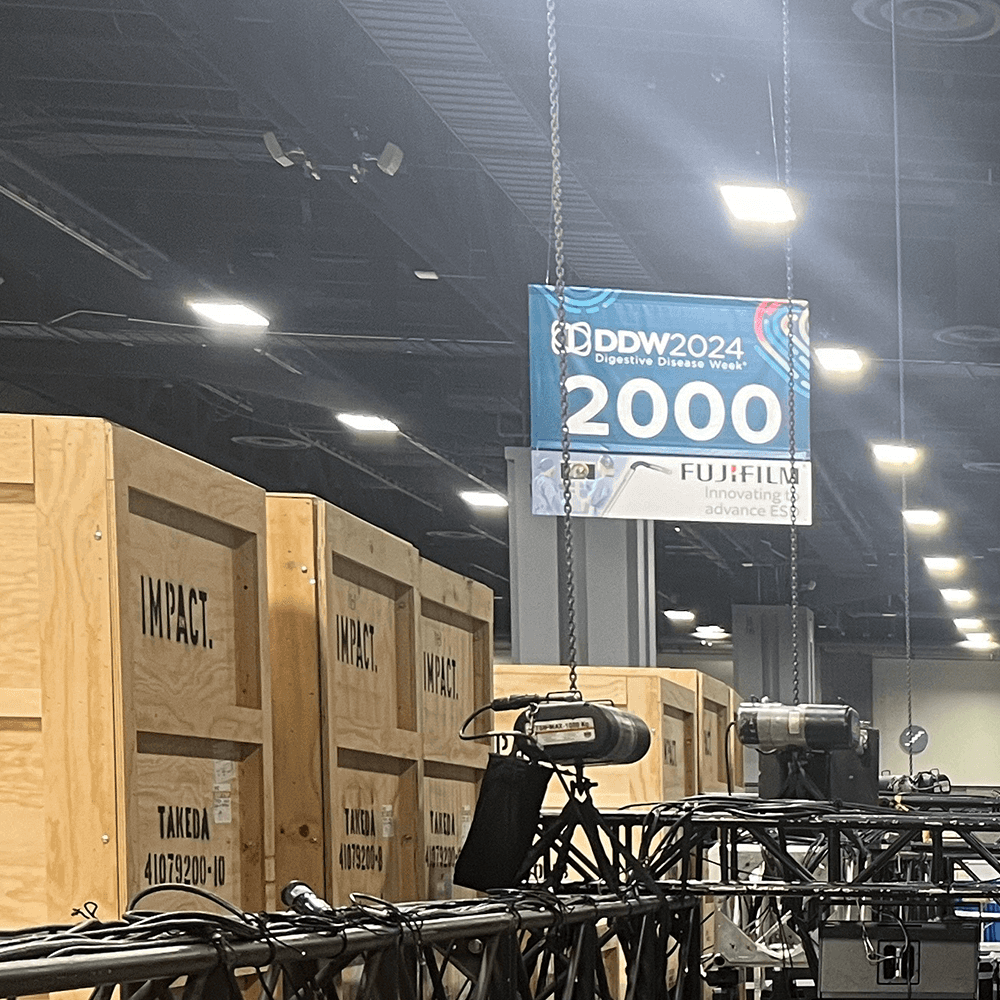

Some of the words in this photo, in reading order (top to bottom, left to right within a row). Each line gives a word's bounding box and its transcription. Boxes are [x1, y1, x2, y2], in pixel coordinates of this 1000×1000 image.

[595, 329, 744, 360] DDW2024
[595, 353, 653, 366] Digestive
[658, 356, 704, 369] Disease
[565, 374, 782, 444] 2000
[681, 463, 799, 485] FUJIFILM
[705, 486, 781, 504] Innovating
[705, 503, 766, 517] advance
[141, 575, 213, 649] IMPACT.
[336, 614, 378, 673] IMPACT.
[423, 651, 459, 700] IMPACT.
[157, 805, 210, 840] TAKEDA
[344, 807, 376, 837] TAKEDA
[430, 810, 456, 836] TAKEDA
[144, 853, 225, 887] 41079200-10
